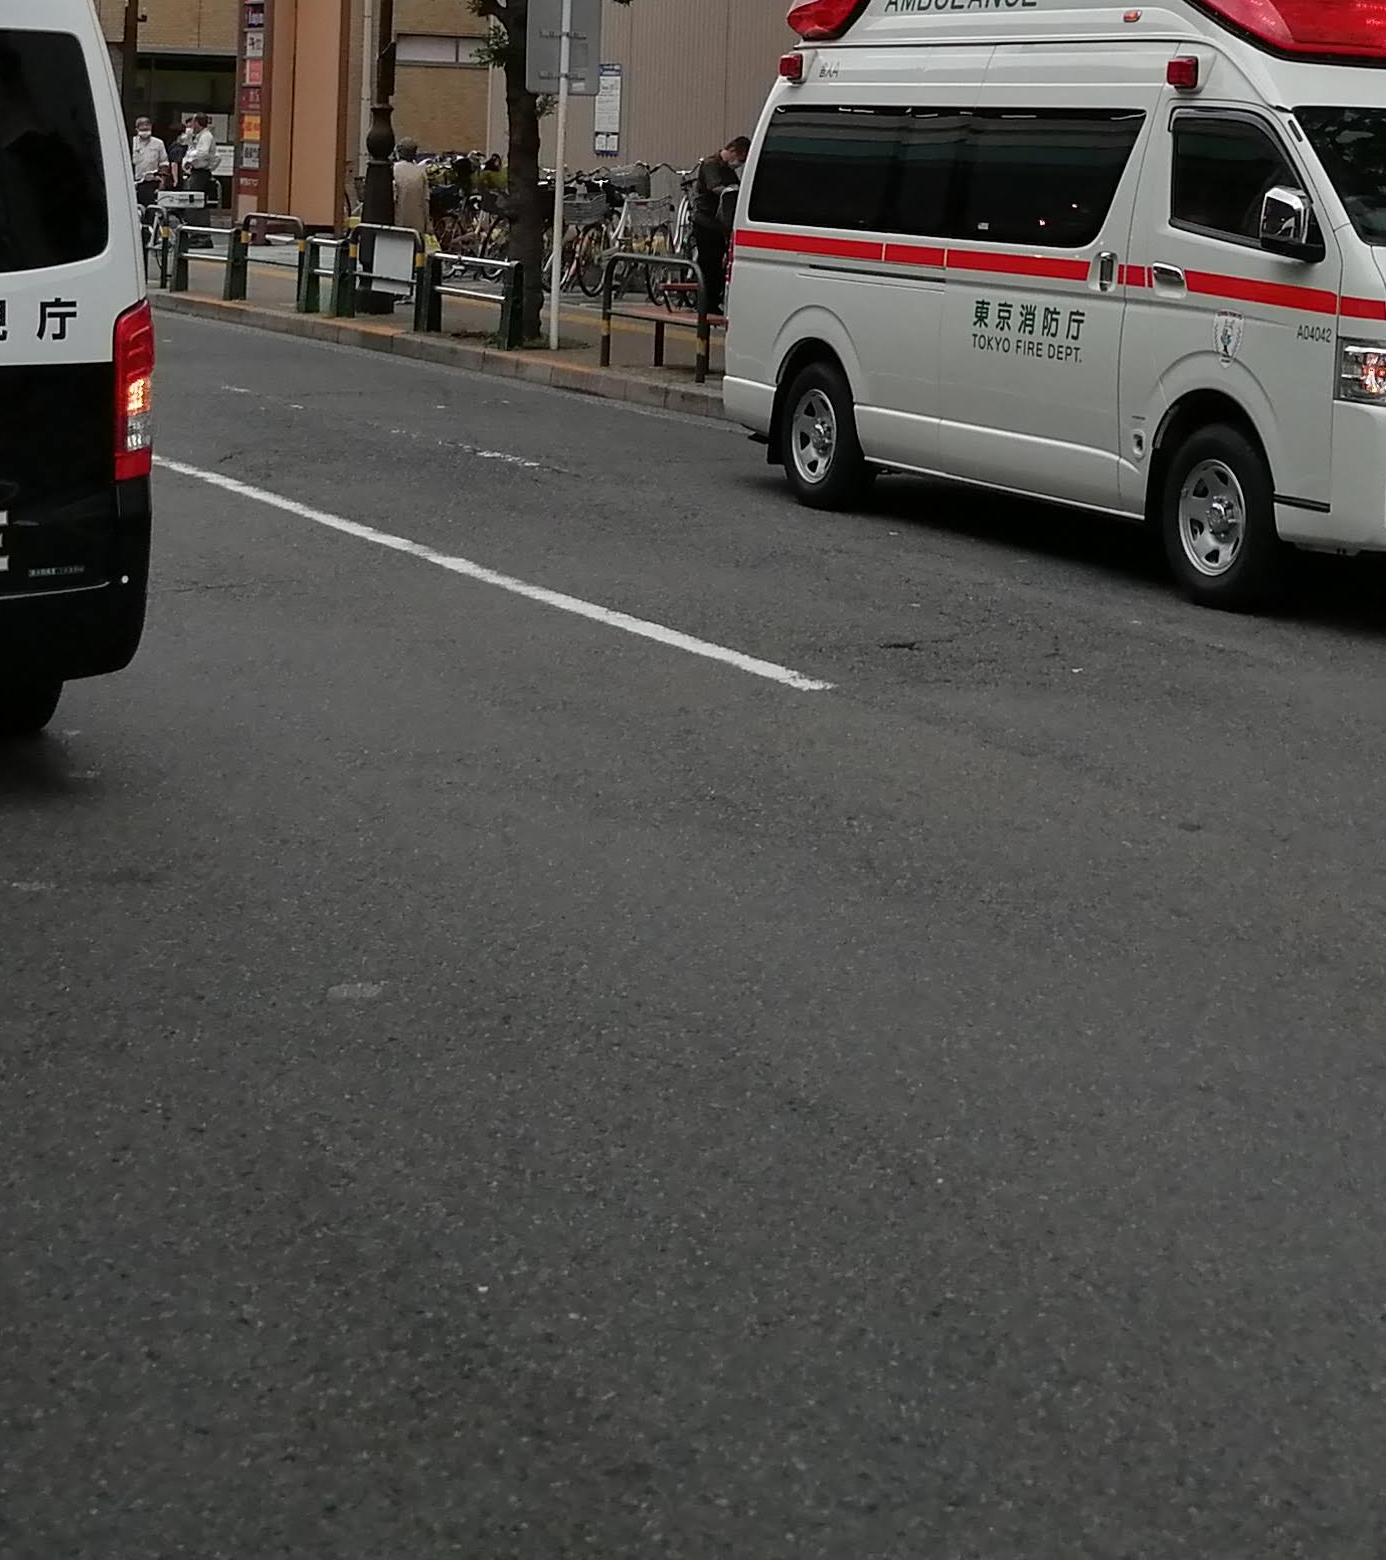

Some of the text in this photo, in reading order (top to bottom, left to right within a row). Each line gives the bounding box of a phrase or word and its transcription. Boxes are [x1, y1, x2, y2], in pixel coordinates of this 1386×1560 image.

[972, 299, 1086, 341] 東京消防庁
[1297, 324, 1332, 344] A04042
[972, 333, 1082, 364] TOKYO FIRE DEPT.
